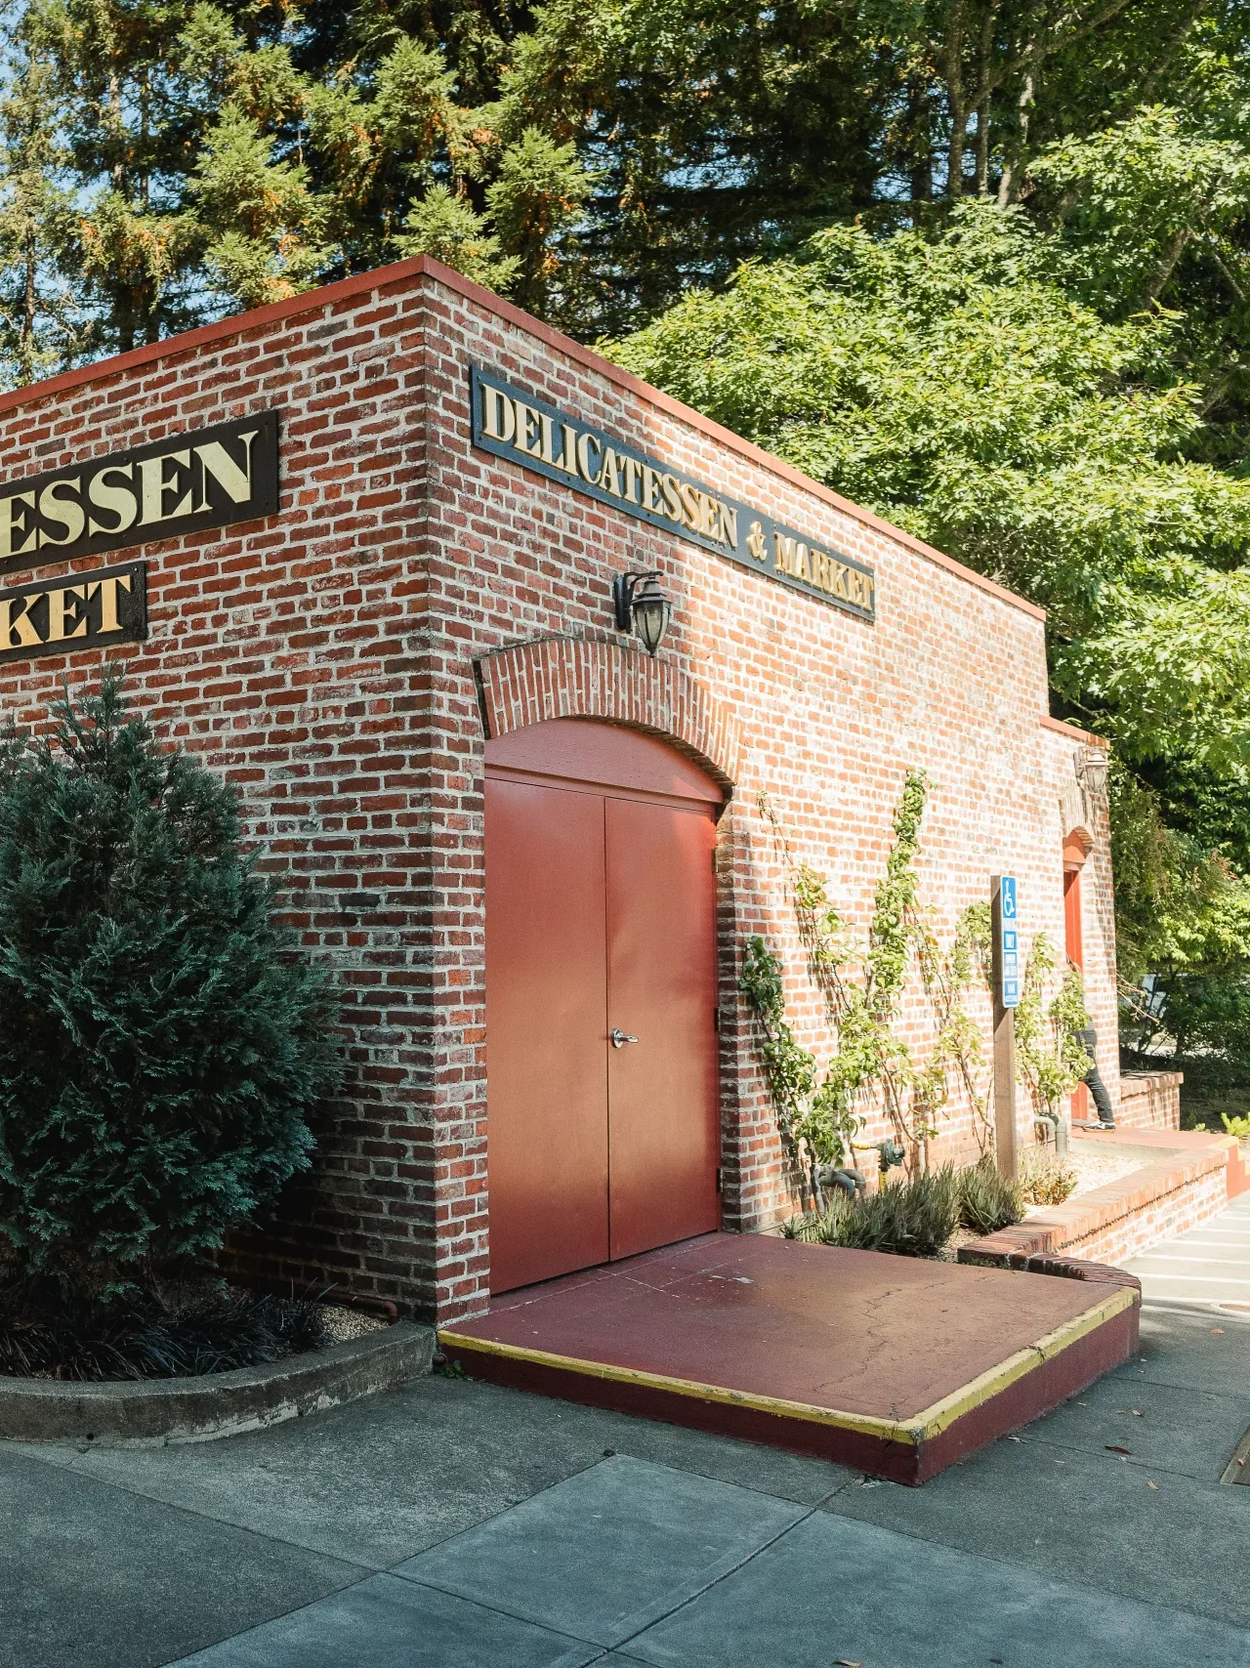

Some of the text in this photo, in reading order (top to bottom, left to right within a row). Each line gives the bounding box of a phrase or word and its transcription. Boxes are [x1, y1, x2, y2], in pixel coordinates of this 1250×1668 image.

[481, 382, 875, 611] DELICATESSEN & MARKET
